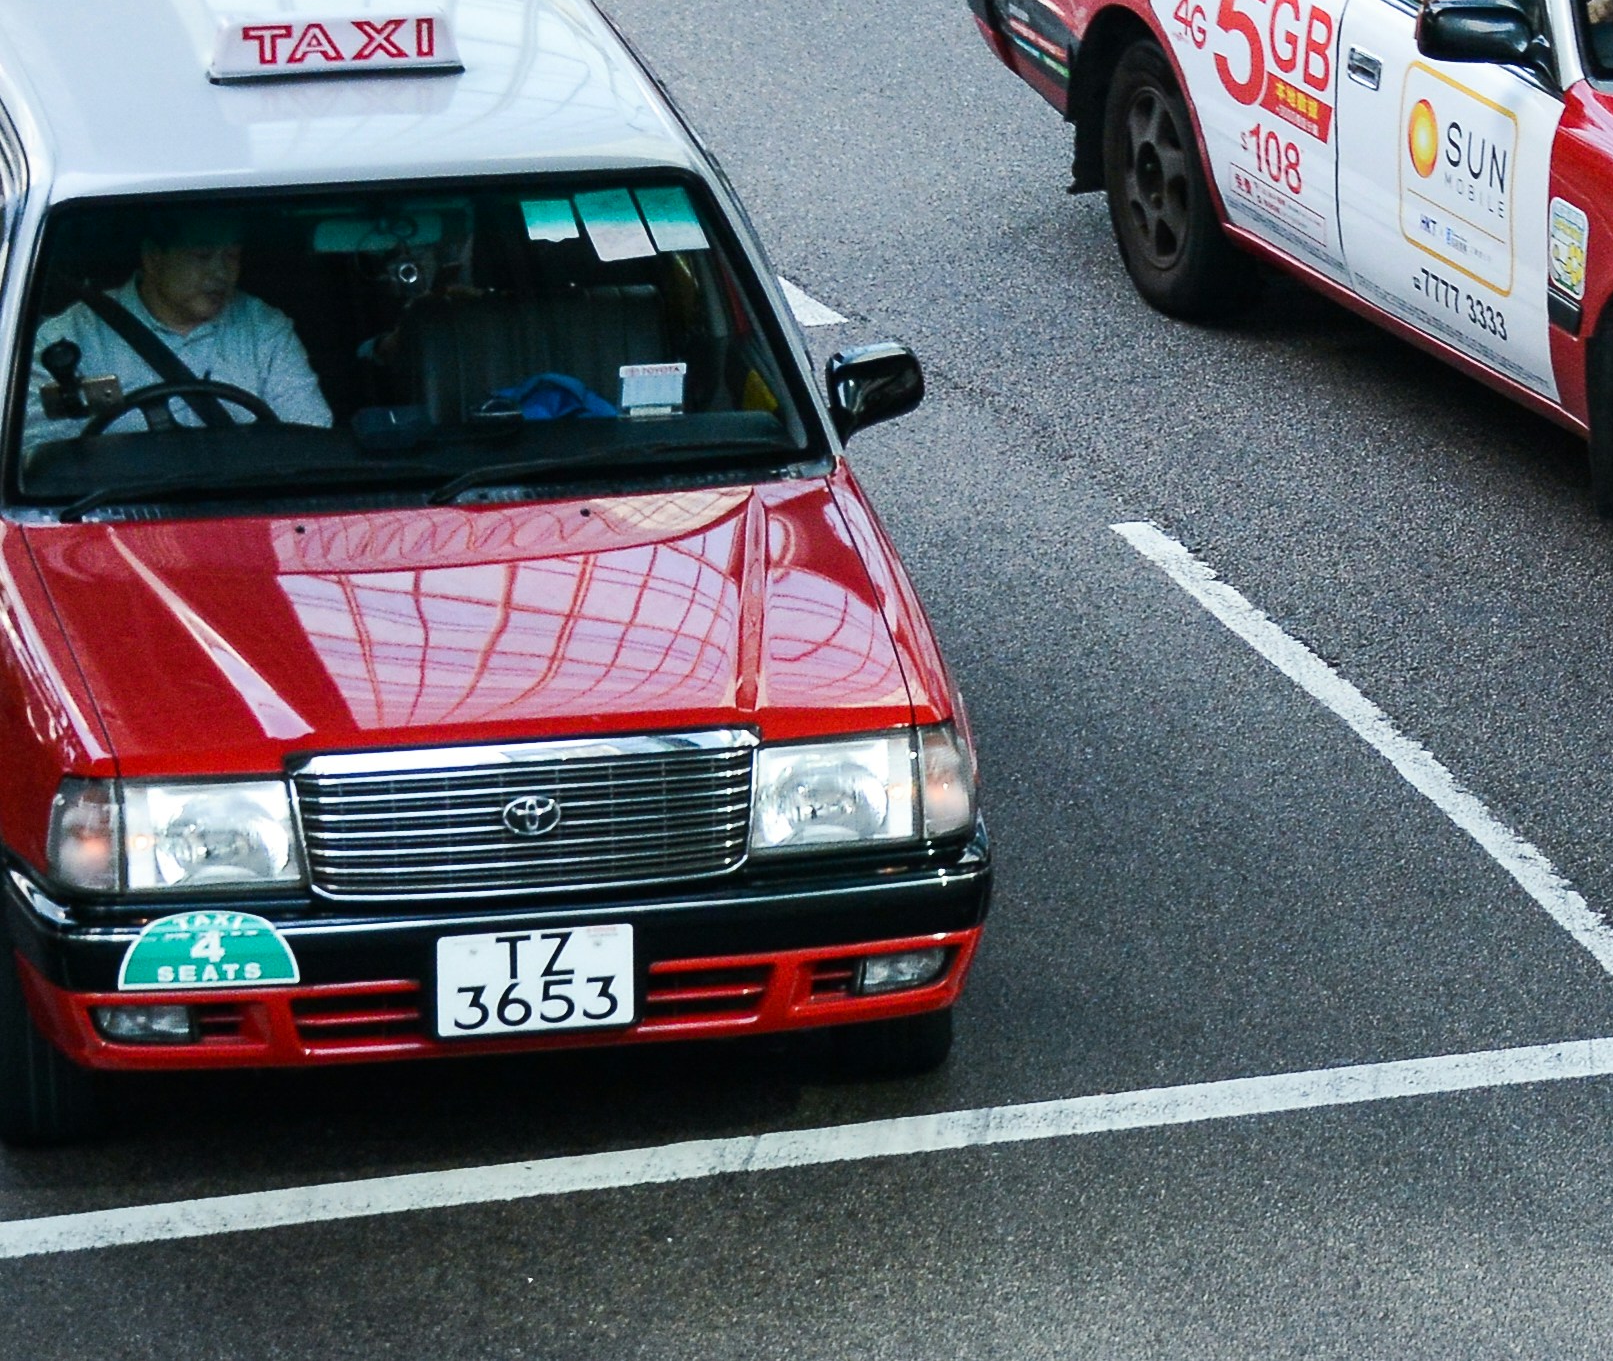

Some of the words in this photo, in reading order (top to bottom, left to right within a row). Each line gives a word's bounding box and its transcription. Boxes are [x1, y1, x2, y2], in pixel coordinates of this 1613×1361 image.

[242, 17, 435, 65] TAXI
[1445, 121, 1507, 194] SUN
[1443, 172, 1505, 219] MOBILE
[1421, 267, 1460, 314] 7777
[1466, 294, 1508, 341] 3333
[643, 365, 680, 375] TOYOTA
[172, 914, 244, 930] TAXI
[190, 930, 225, 963] 4
[495, 932, 575, 980] TZ
[157, 962, 262, 983] SEATS
[454, 975, 618, 1030] 3653
